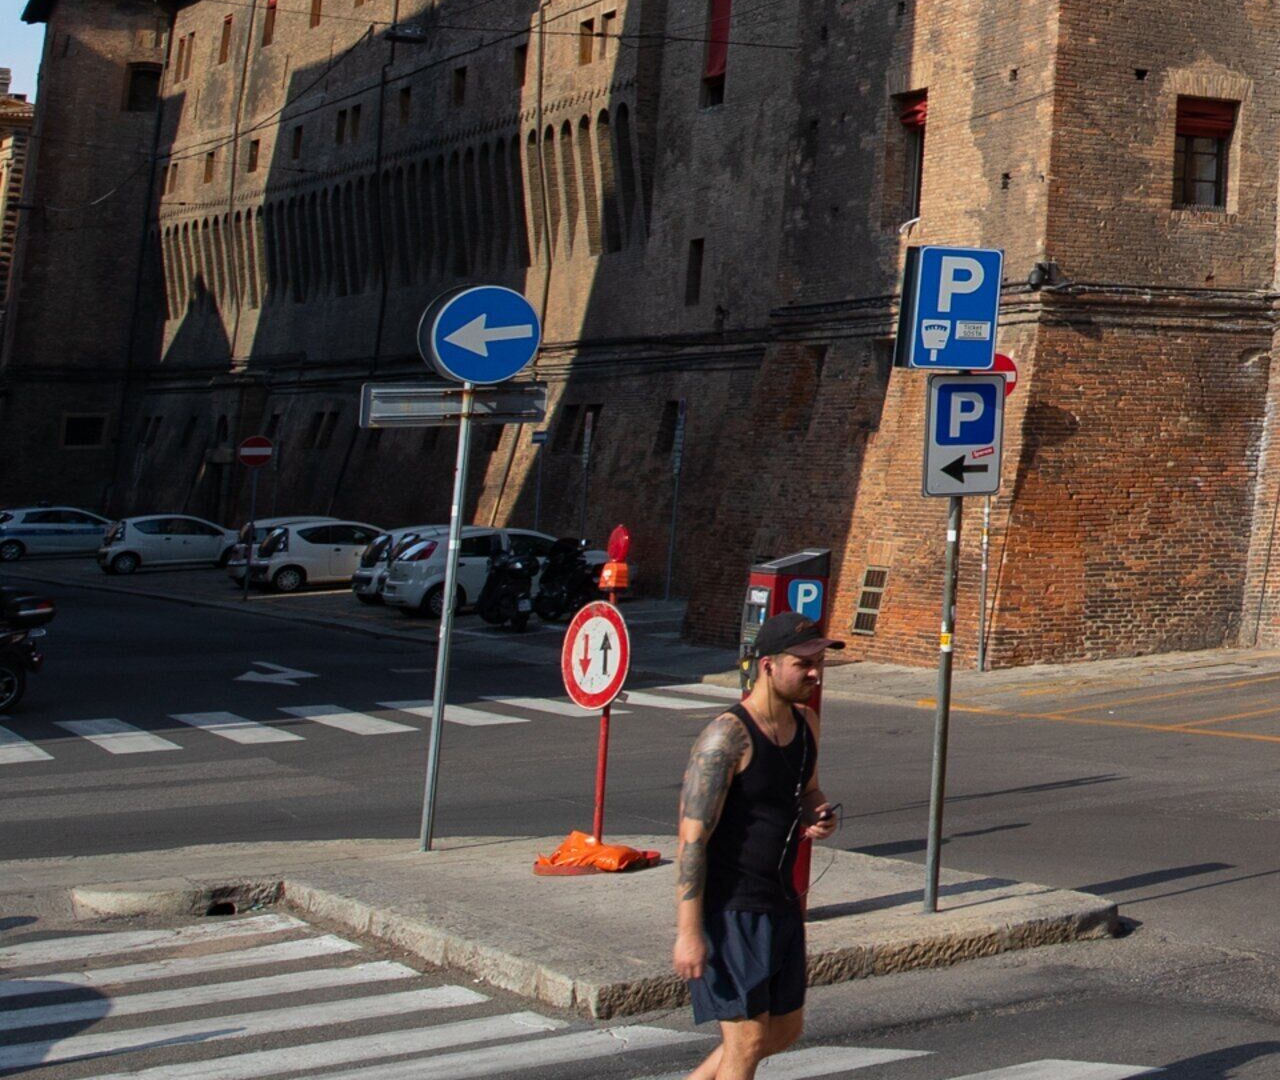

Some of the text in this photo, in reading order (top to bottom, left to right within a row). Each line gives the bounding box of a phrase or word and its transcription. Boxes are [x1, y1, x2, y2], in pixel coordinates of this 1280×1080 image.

[937, 256, 985, 313] P
[948, 391, 985, 438] P
[796, 583, 818, 614] P
